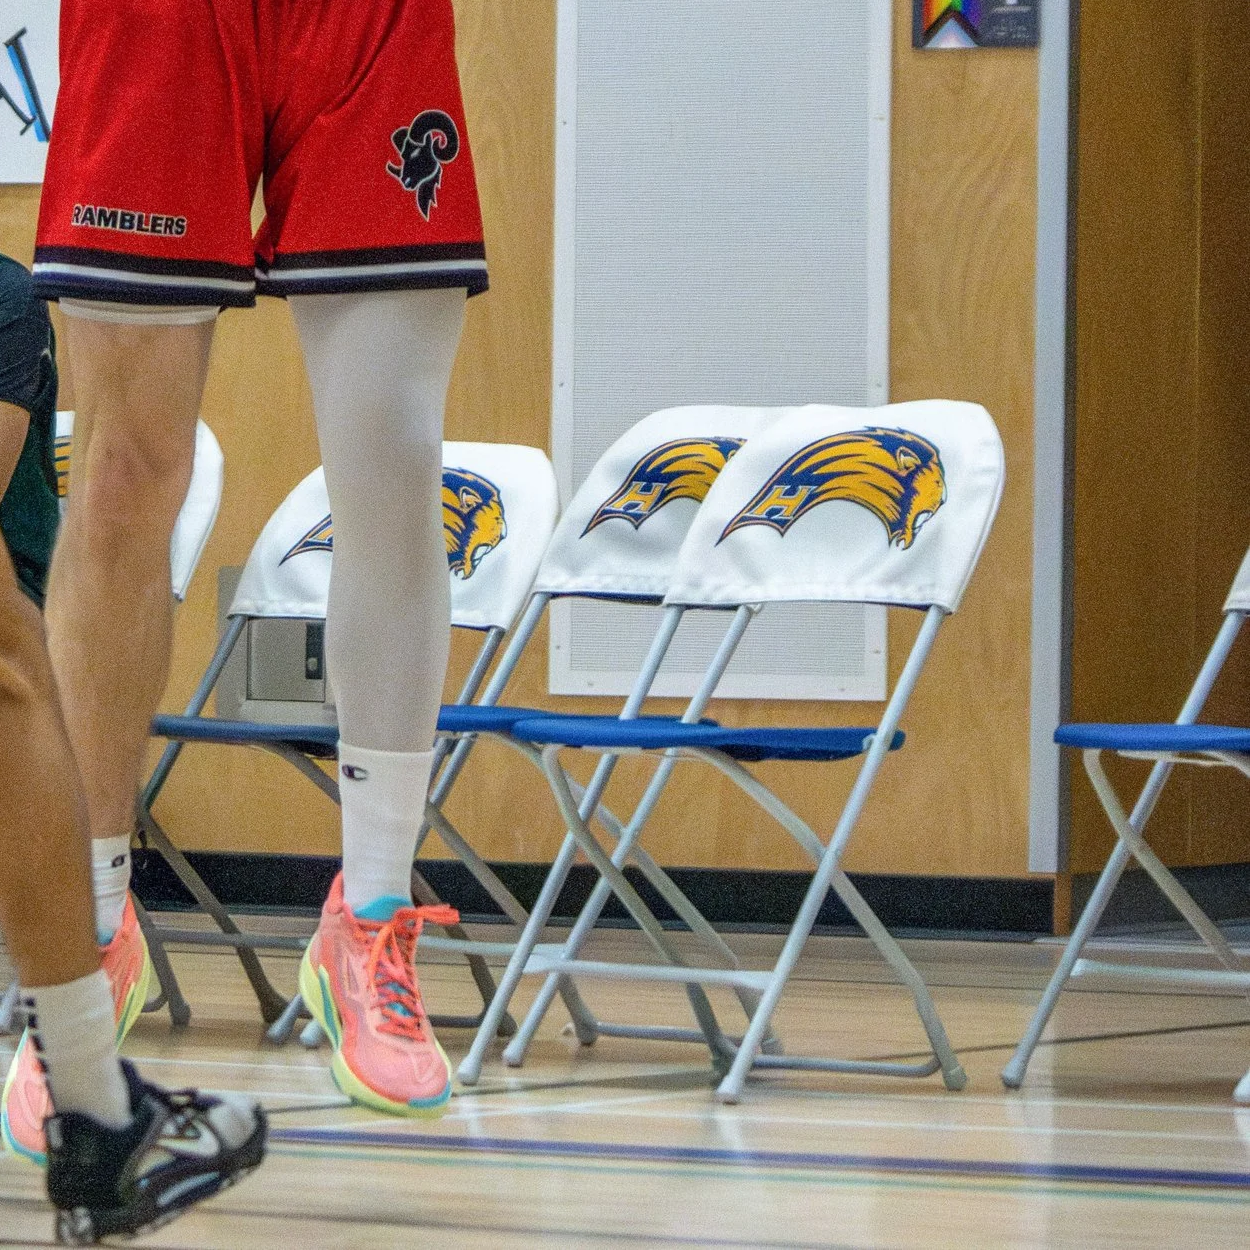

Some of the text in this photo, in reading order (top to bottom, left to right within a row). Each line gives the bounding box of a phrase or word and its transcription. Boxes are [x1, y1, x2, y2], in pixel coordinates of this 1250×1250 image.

[71, 203, 188, 239] RAMBLERS
[605, 480, 668, 515] H
[745, 484, 819, 521] H
